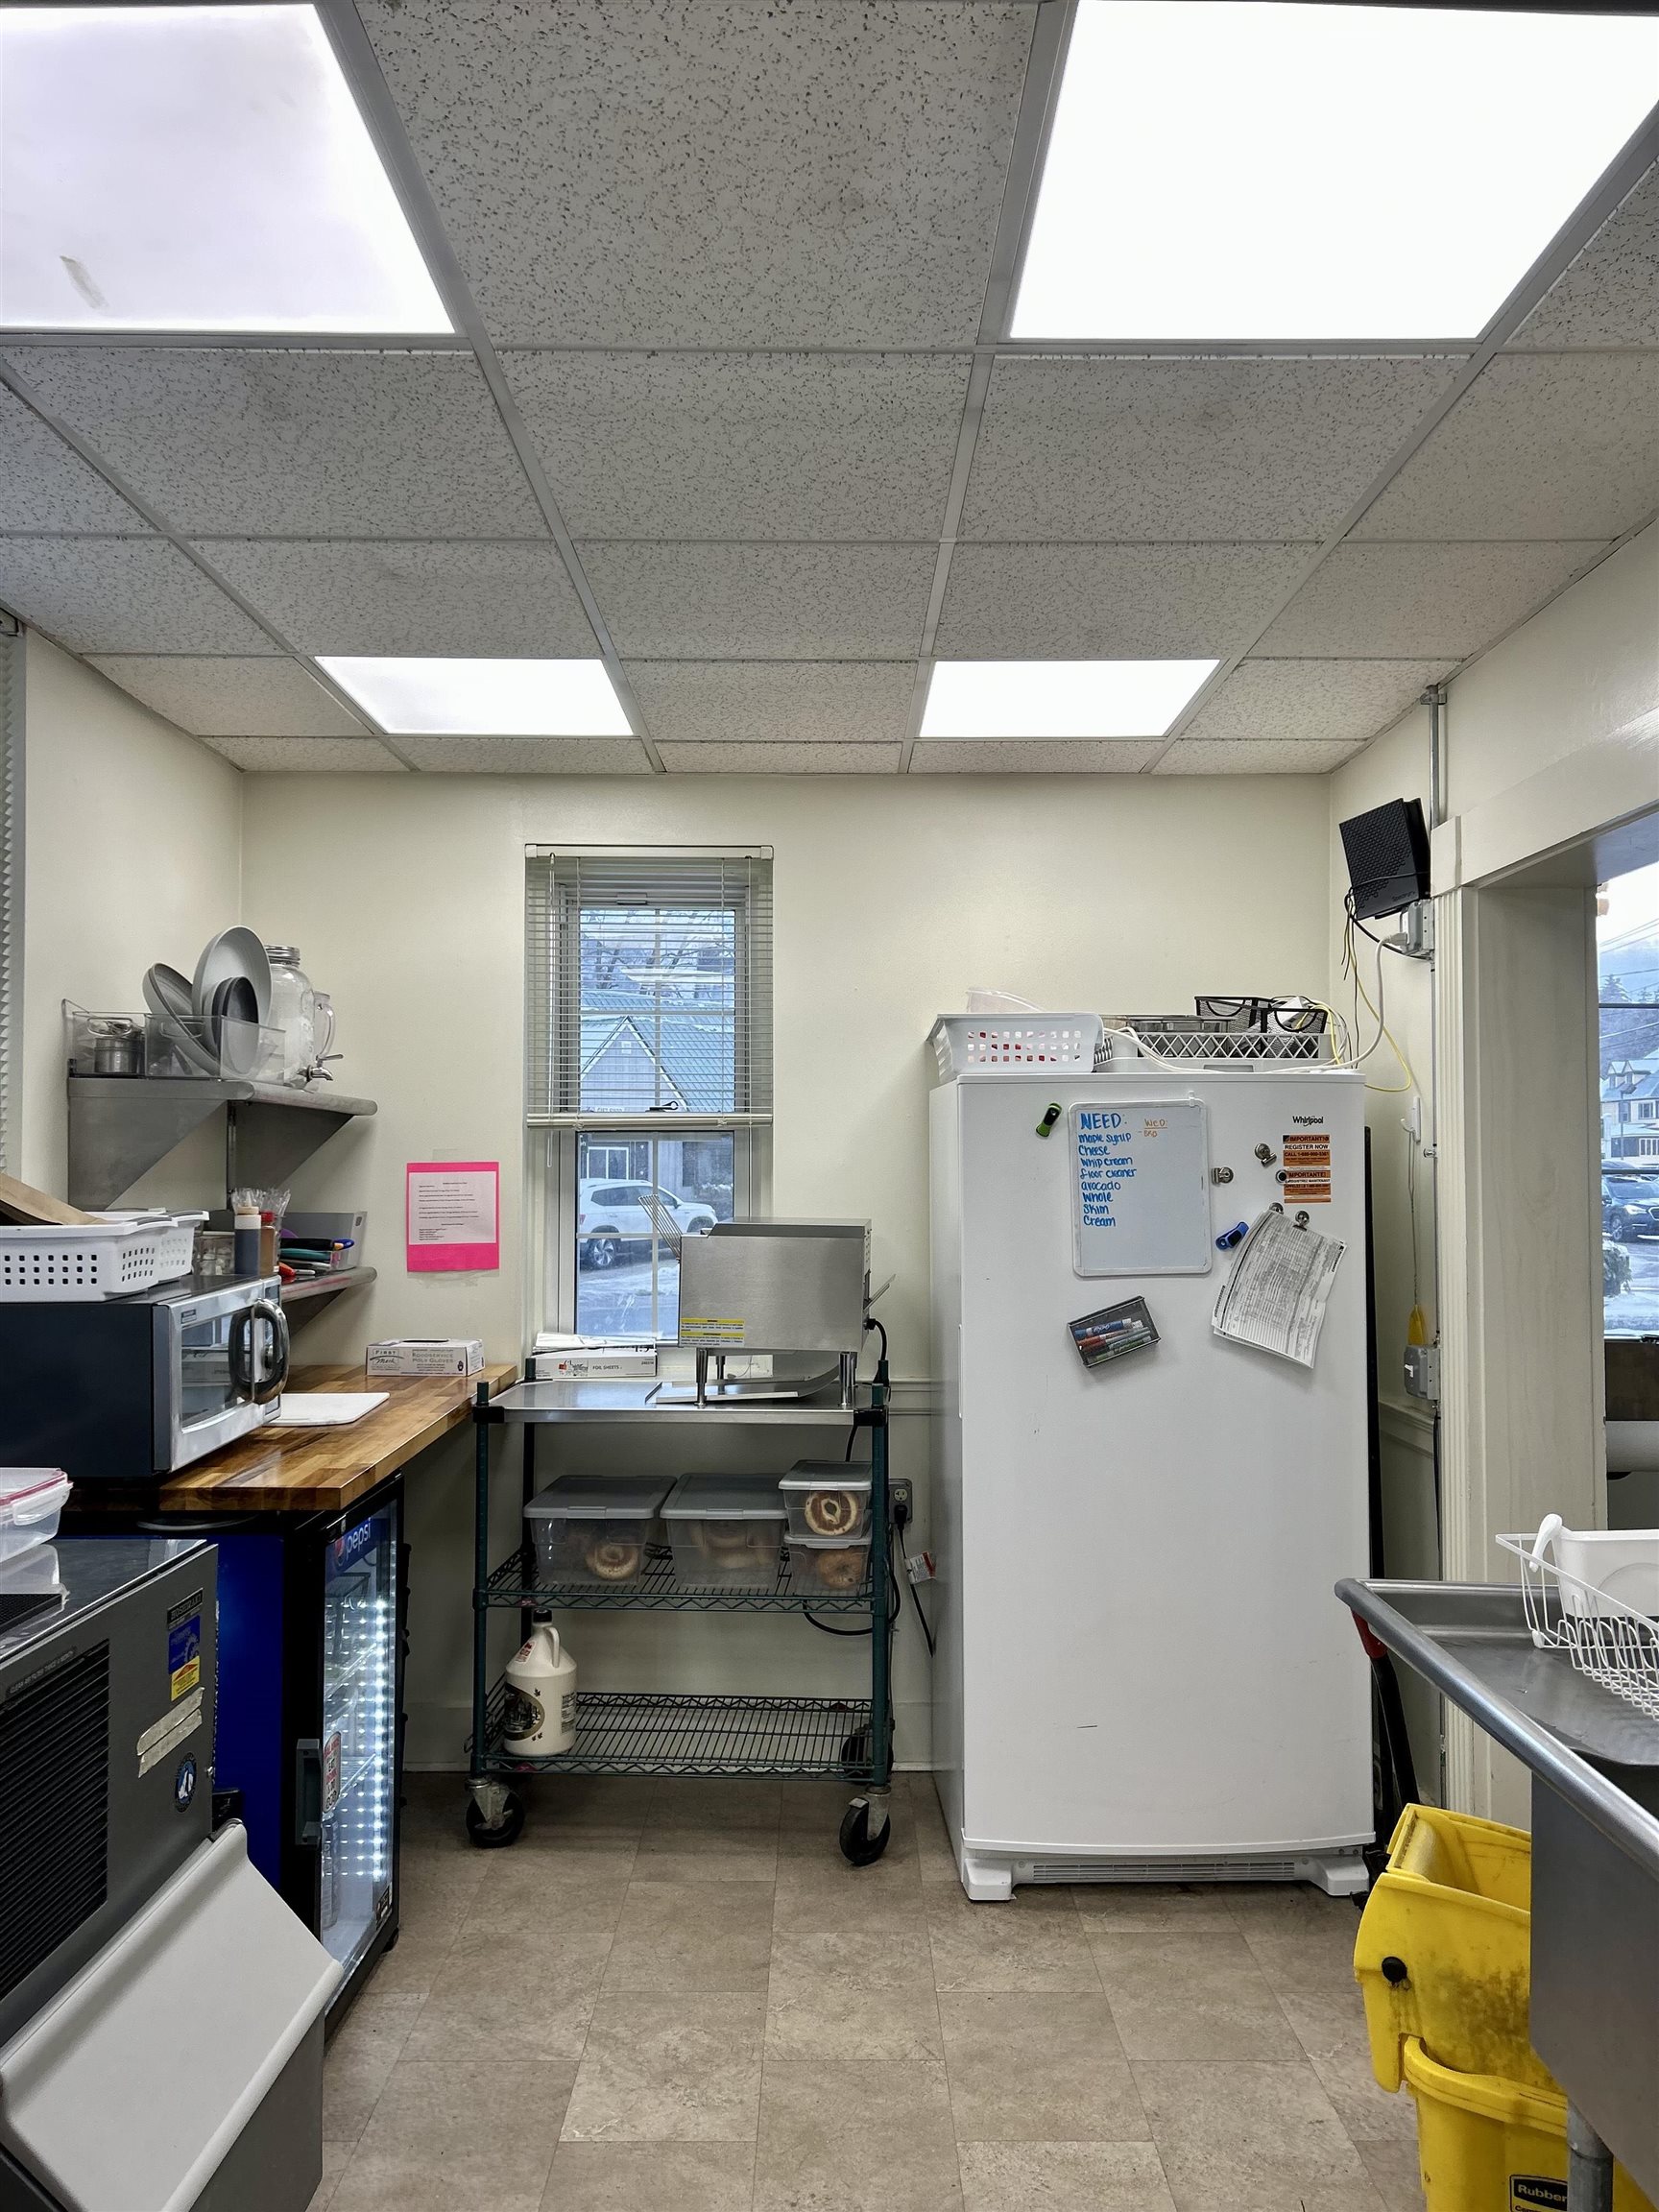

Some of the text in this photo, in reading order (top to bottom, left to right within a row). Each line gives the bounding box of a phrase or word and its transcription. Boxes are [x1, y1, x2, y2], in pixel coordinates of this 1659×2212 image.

[1292, 1116, 1324, 1127] Whirlpool
[1106, 1133, 1132, 1145] syrup
[346, 1517, 372, 1561] pepsi
